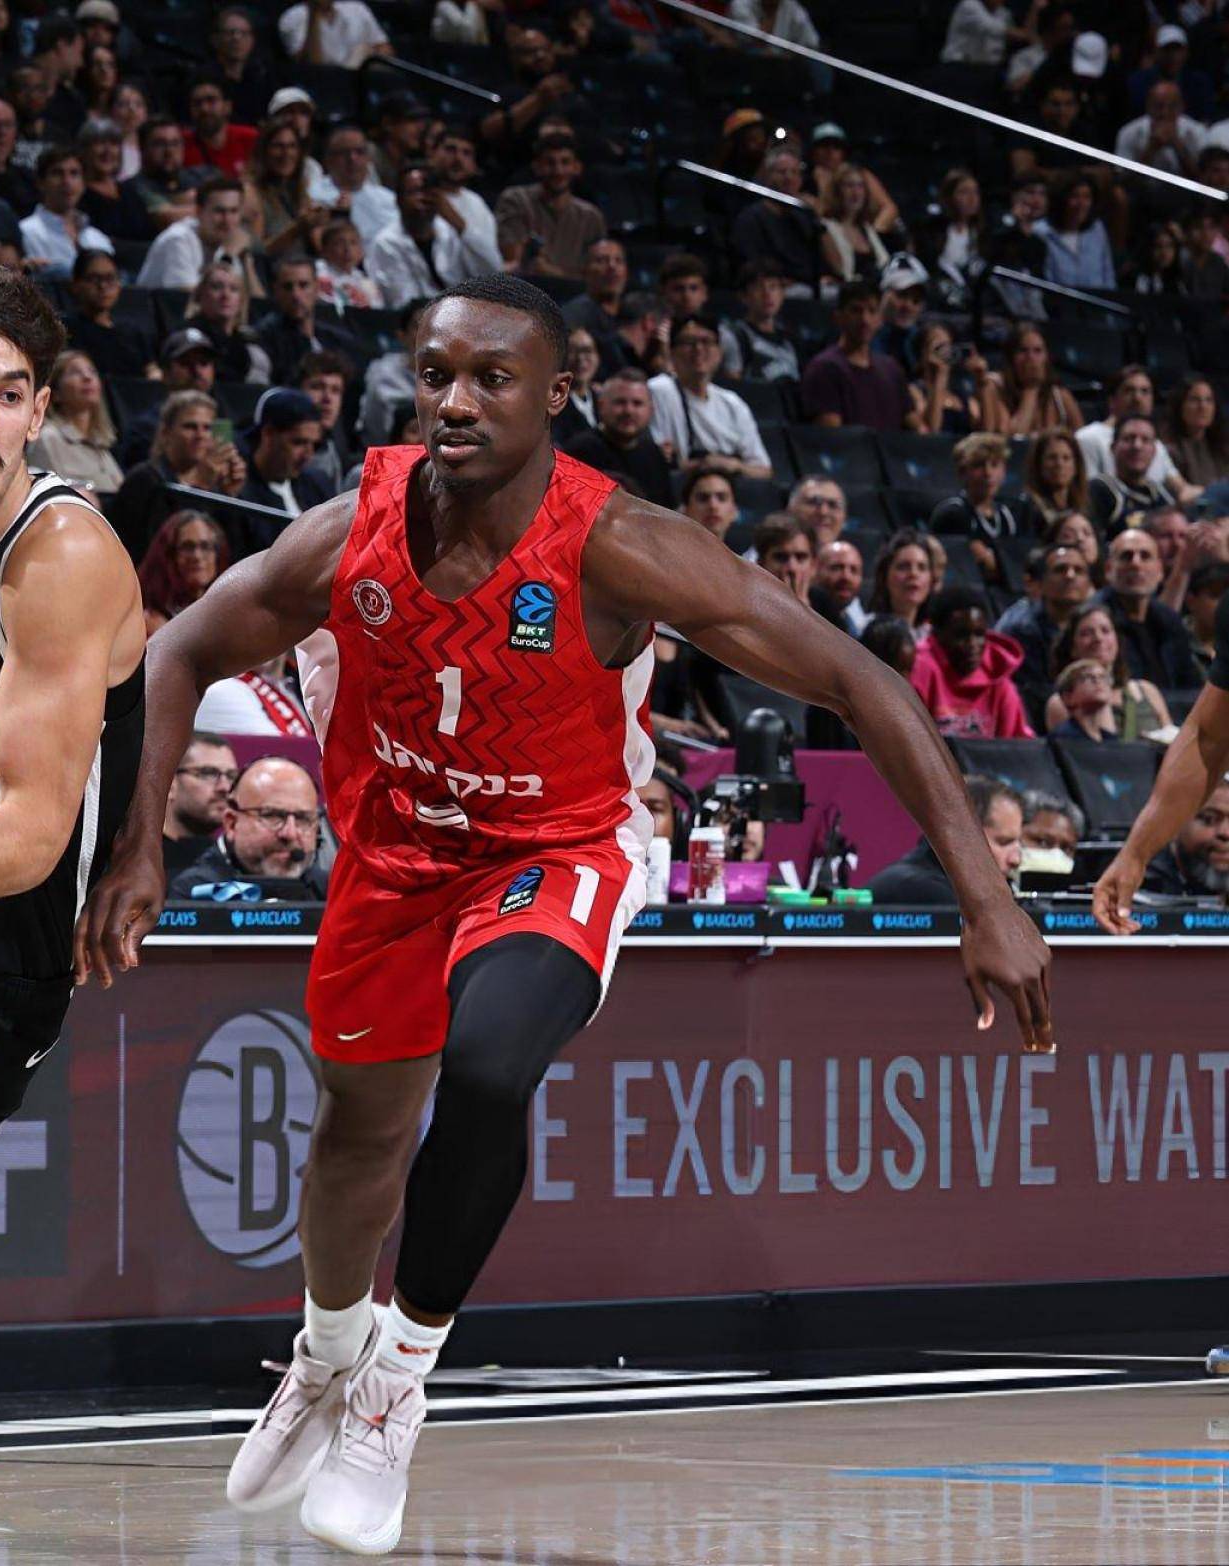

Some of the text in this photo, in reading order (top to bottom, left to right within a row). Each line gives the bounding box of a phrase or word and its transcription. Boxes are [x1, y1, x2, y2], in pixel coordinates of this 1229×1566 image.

[516, 623, 547, 636] BKT
[511, 636, 551, 649] EuroCup
[435, 665, 462, 737] 1
[445, 767, 544, 799] בנק
[570, 864, 600, 927] 1
[245, 911, 301, 926] BARCLAYS
[705, 912, 755, 928] BARCLAYS
[795, 913, 844, 929] BARCLAYS
[884, 914, 932, 929] BARCLAYS
[613, 1054, 1056, 1197] EXCLUSIVE
